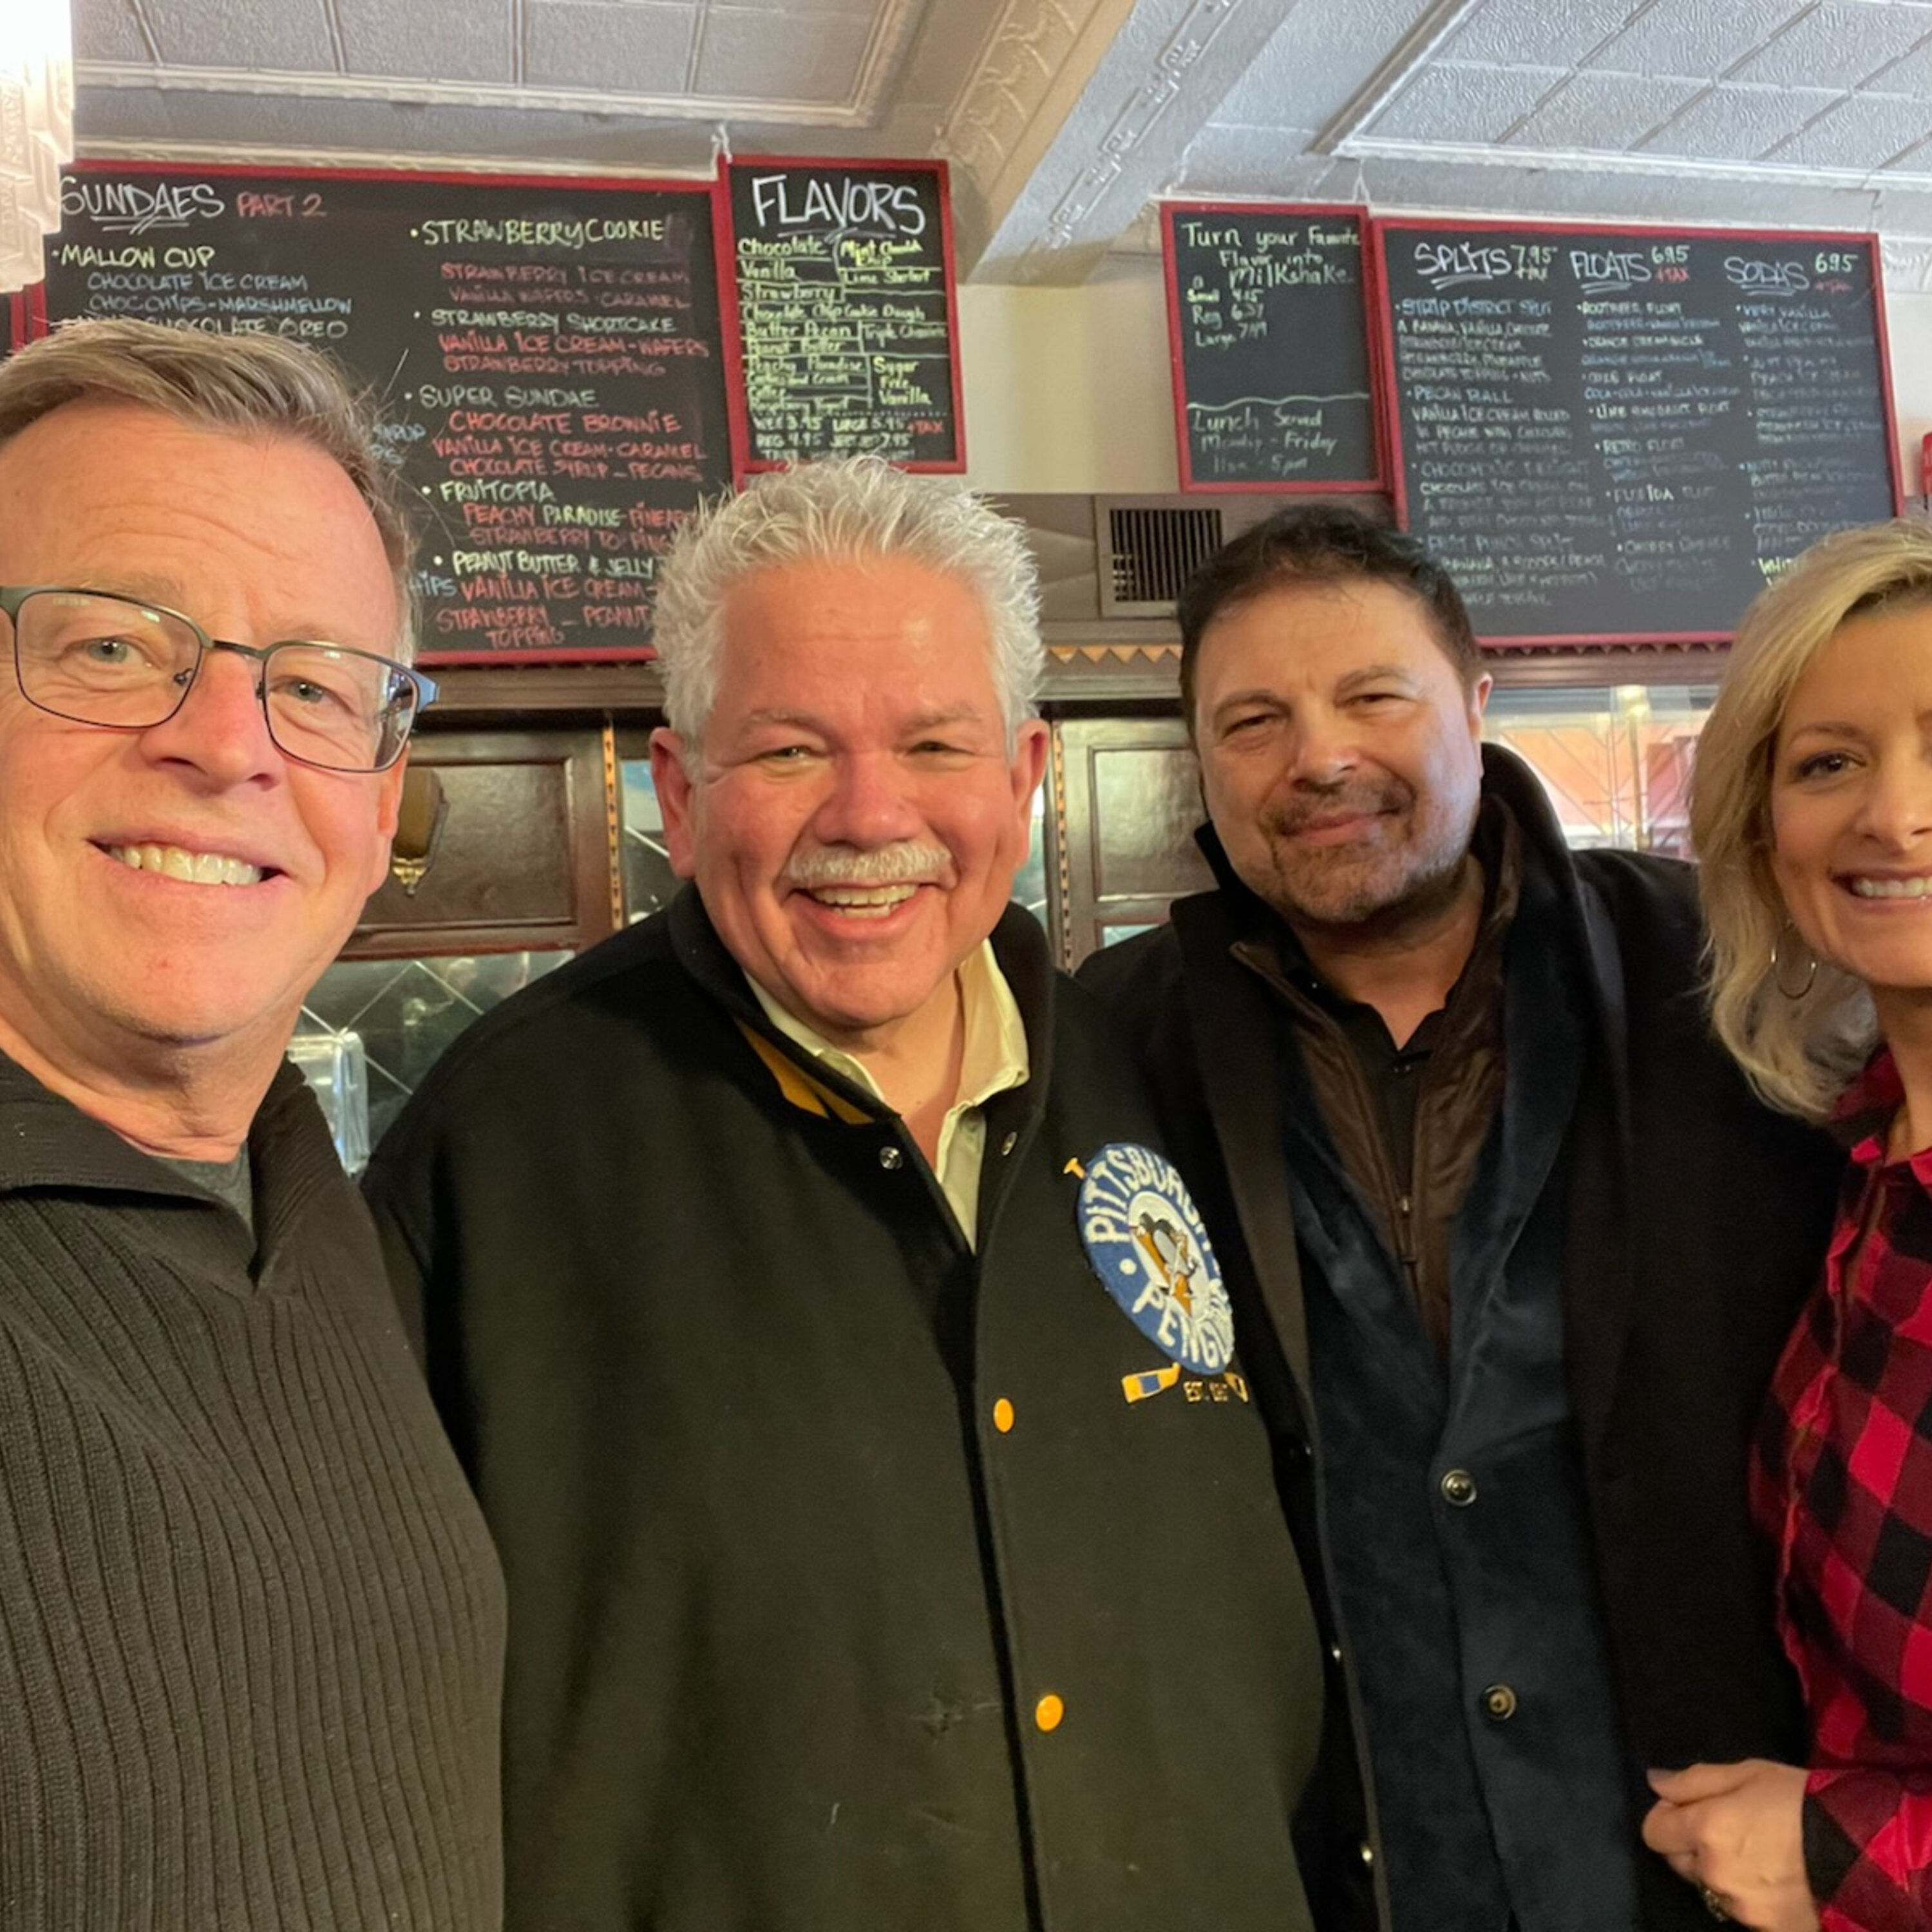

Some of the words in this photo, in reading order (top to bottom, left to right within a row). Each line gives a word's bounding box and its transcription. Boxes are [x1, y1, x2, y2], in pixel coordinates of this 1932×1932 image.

[61, 176, 225, 218] SUNDAES
[235, 193, 294, 217] PART
[303, 194, 327, 216] 2
[752, 174, 925, 234] FLAVORS
[421, 219, 585, 249] STRAWBERRY
[585, 218, 665, 240] COOKIE
[737, 235, 829, 256] Chocolate
[1182, 222, 1242, 247] Turn
[1256, 231, 1298, 253] your
[61, 245, 155, 268] MALLOW
[164, 247, 215, 268] CUP
[1414, 242, 1512, 275] SPLITS
[1569, 250, 1653, 282] FLOATS
[88, 272, 193, 290] CHOCOLATE
[198, 271, 236, 290] ICE
[240, 274, 308, 292] CREAM
[1724, 256, 1810, 290] SODAS
[278, 317, 348, 339] OREO
[431, 309, 559, 334] STRAWBERRY
[438, 329, 508, 354] VANILLA
[514, 329, 552, 354] ICE
[554, 333, 627, 355] CREAM
[419, 385, 498, 408] SUPER
[504, 388, 600, 409] SUNDAE
[449, 411, 573, 433] CHOCOLATE
[583, 410, 683, 434] BROWNIE
[1192, 406, 1259, 433] Lunch
[433, 435, 503, 457] VANILLA
[508, 438, 542, 458] ICE
[450, 459, 547, 478] CHOCOLATE
[439, 479, 557, 504] FRUITOPIA
[463, 504, 536, 527] PEACHY
[452, 551, 513, 575] PEANUT
[517, 553, 582, 575] BUTTER
[604, 558, 654, 579] JELLY
[461, 574, 538, 602] VANILLA
[543, 574, 580, 600] ICE
